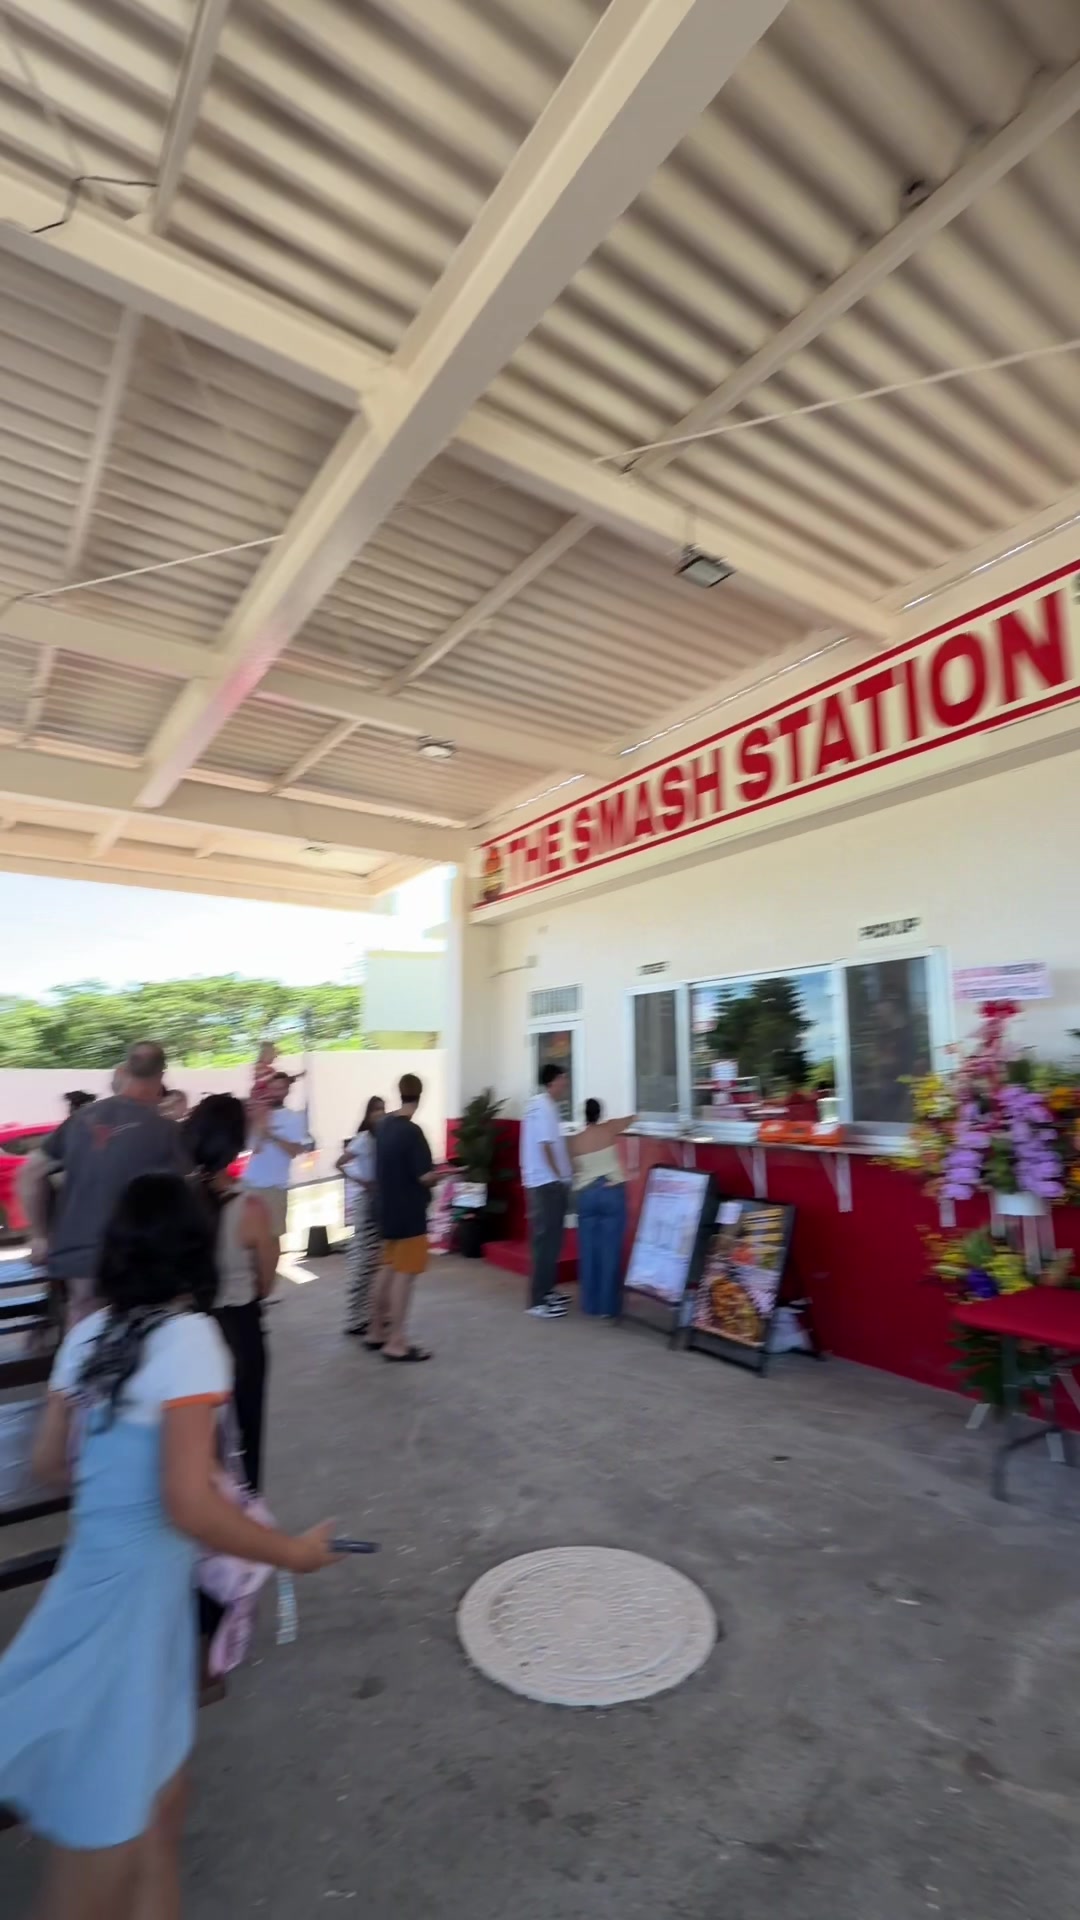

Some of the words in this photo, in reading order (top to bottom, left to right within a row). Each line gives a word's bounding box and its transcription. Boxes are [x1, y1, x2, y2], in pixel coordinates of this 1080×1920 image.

[506, 820, 567, 888] THE
[571, 746, 724, 864] SMASH
[738, 590, 1071, 802] STATION
